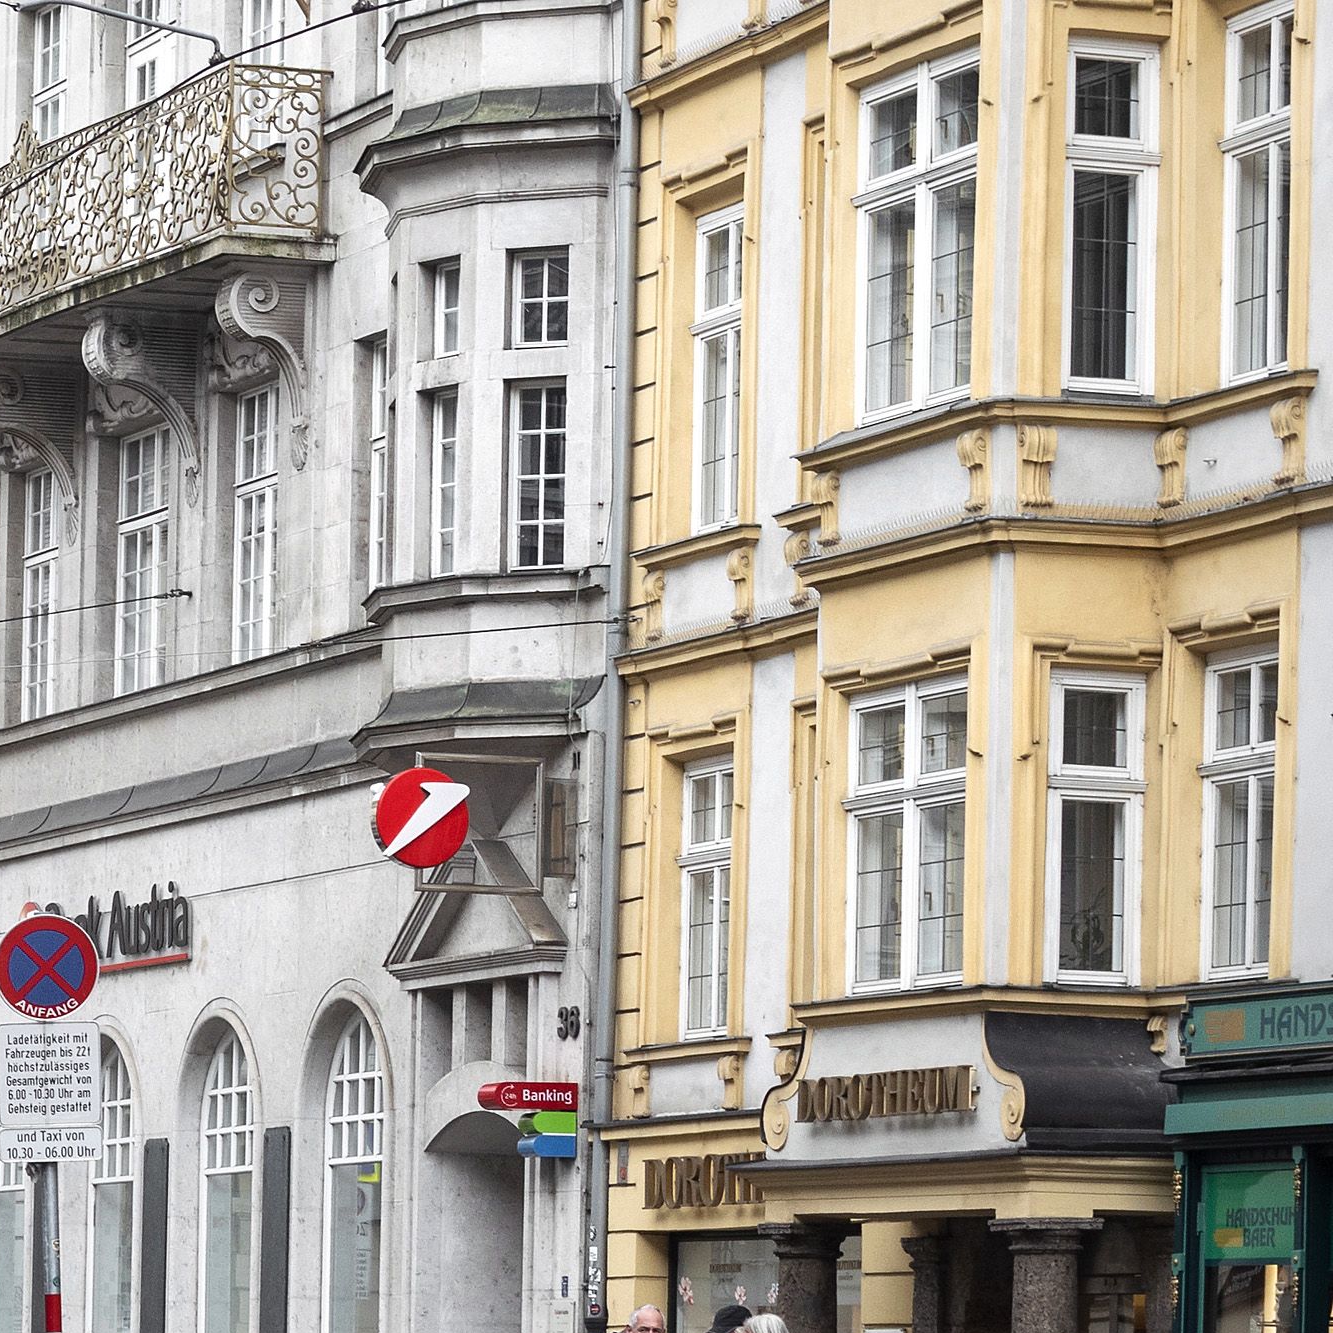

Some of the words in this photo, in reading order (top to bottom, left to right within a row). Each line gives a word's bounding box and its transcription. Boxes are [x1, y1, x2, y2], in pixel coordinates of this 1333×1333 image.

[106, 881, 191, 958] Austria
[15, 997, 79, 1018] ANFANG
[556, 1005, 580, 1040] 36
[7, 1032, 70, 1047] Ladetätigkeit
[73, 1032, 88, 1044] mit
[5, 1048, 57, 1060] Fahrzeugen
[59, 1046, 73, 1058] bis
[7, 1061, 90, 1073] höchstzulässiges
[6, 1075, 73, 1088] Gesamtgewicht
[76, 1075, 92, 1085] von
[8, 1088, 27, 1100] 6.00
[58, 1088, 74, 1099] Uhr
[77, 1090, 91, 1099] am
[522, 1088, 573, 1105] Banking
[795, 1064, 975, 1124] DOROTHEUM
[8, 1103, 47, 1116] Gehsteig
[50, 1101, 92, 1116] gestattet
[17, 1131, 37, 1143] und
[40, 1129, 62, 1142] Taxi
[65, 1131, 85, 1141] von
[7, 1147, 33, 1159] 10.30
[45, 1146, 74, 1158] 06.00
[77, 1145, 96, 1158] Uhr
[642, 1152, 765, 1210] DOROTH
